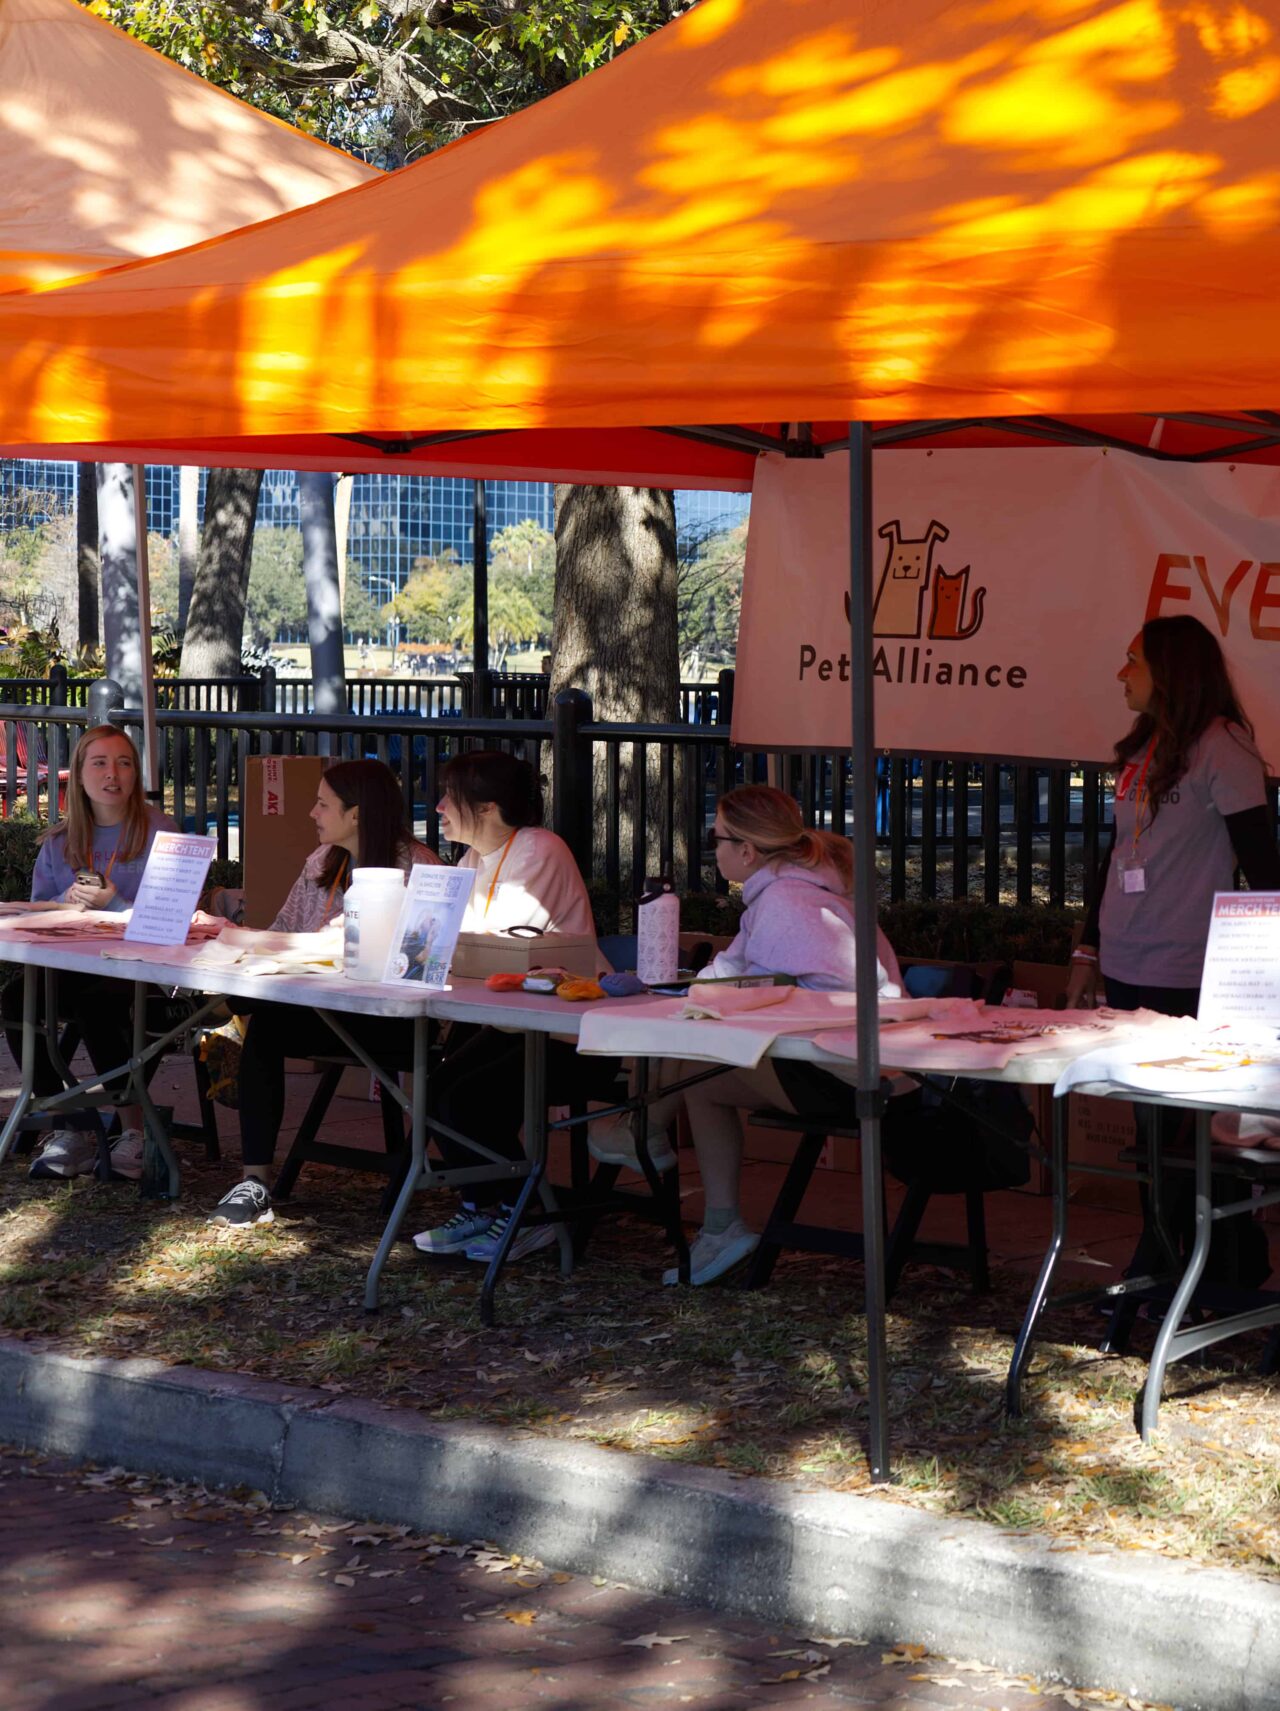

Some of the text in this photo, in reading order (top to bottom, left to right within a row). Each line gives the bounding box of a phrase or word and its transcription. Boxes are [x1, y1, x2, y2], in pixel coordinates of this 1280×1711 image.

[798, 644, 1028, 689] Pet Alliance
[157, 843, 211, 857] MERCH TENT
[1218, 904, 1262, 915] MERCH
